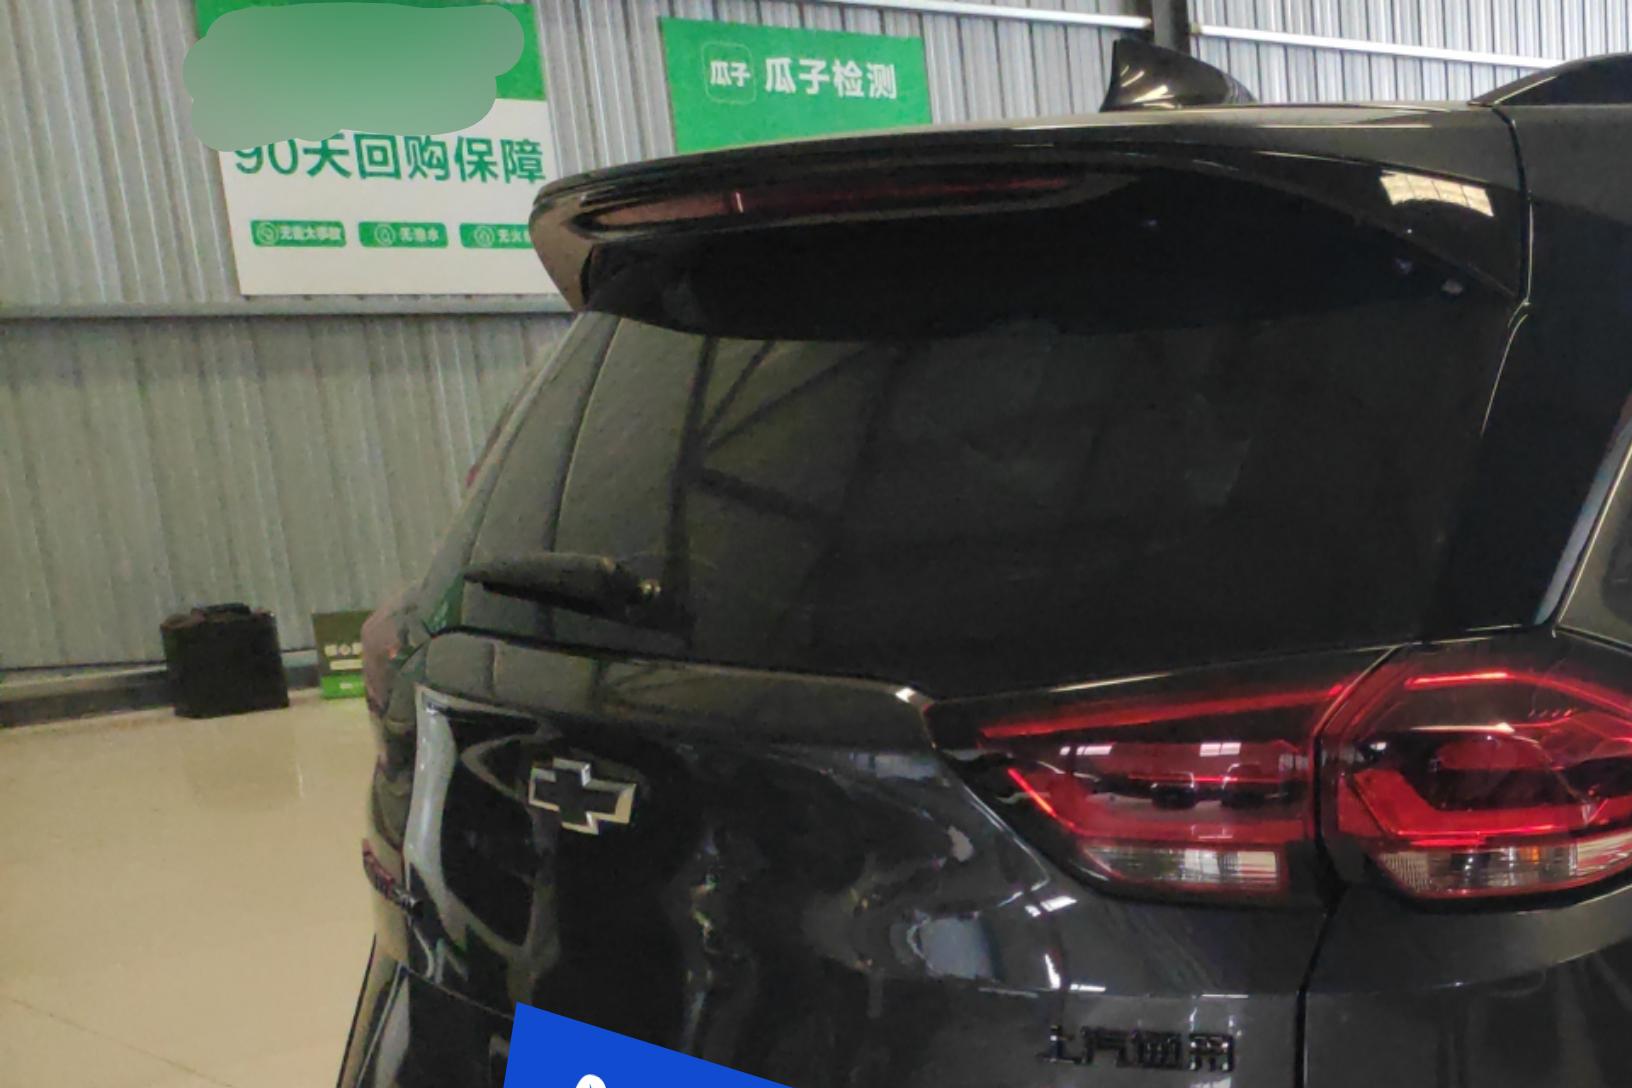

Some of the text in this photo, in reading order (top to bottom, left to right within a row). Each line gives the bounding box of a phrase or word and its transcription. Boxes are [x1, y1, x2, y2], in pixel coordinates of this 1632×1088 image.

[709, 60, 751, 87] 瓜子
[764, 56, 898, 100] 瓜子检测
[234, 132, 547, 184] 90天回购保障
